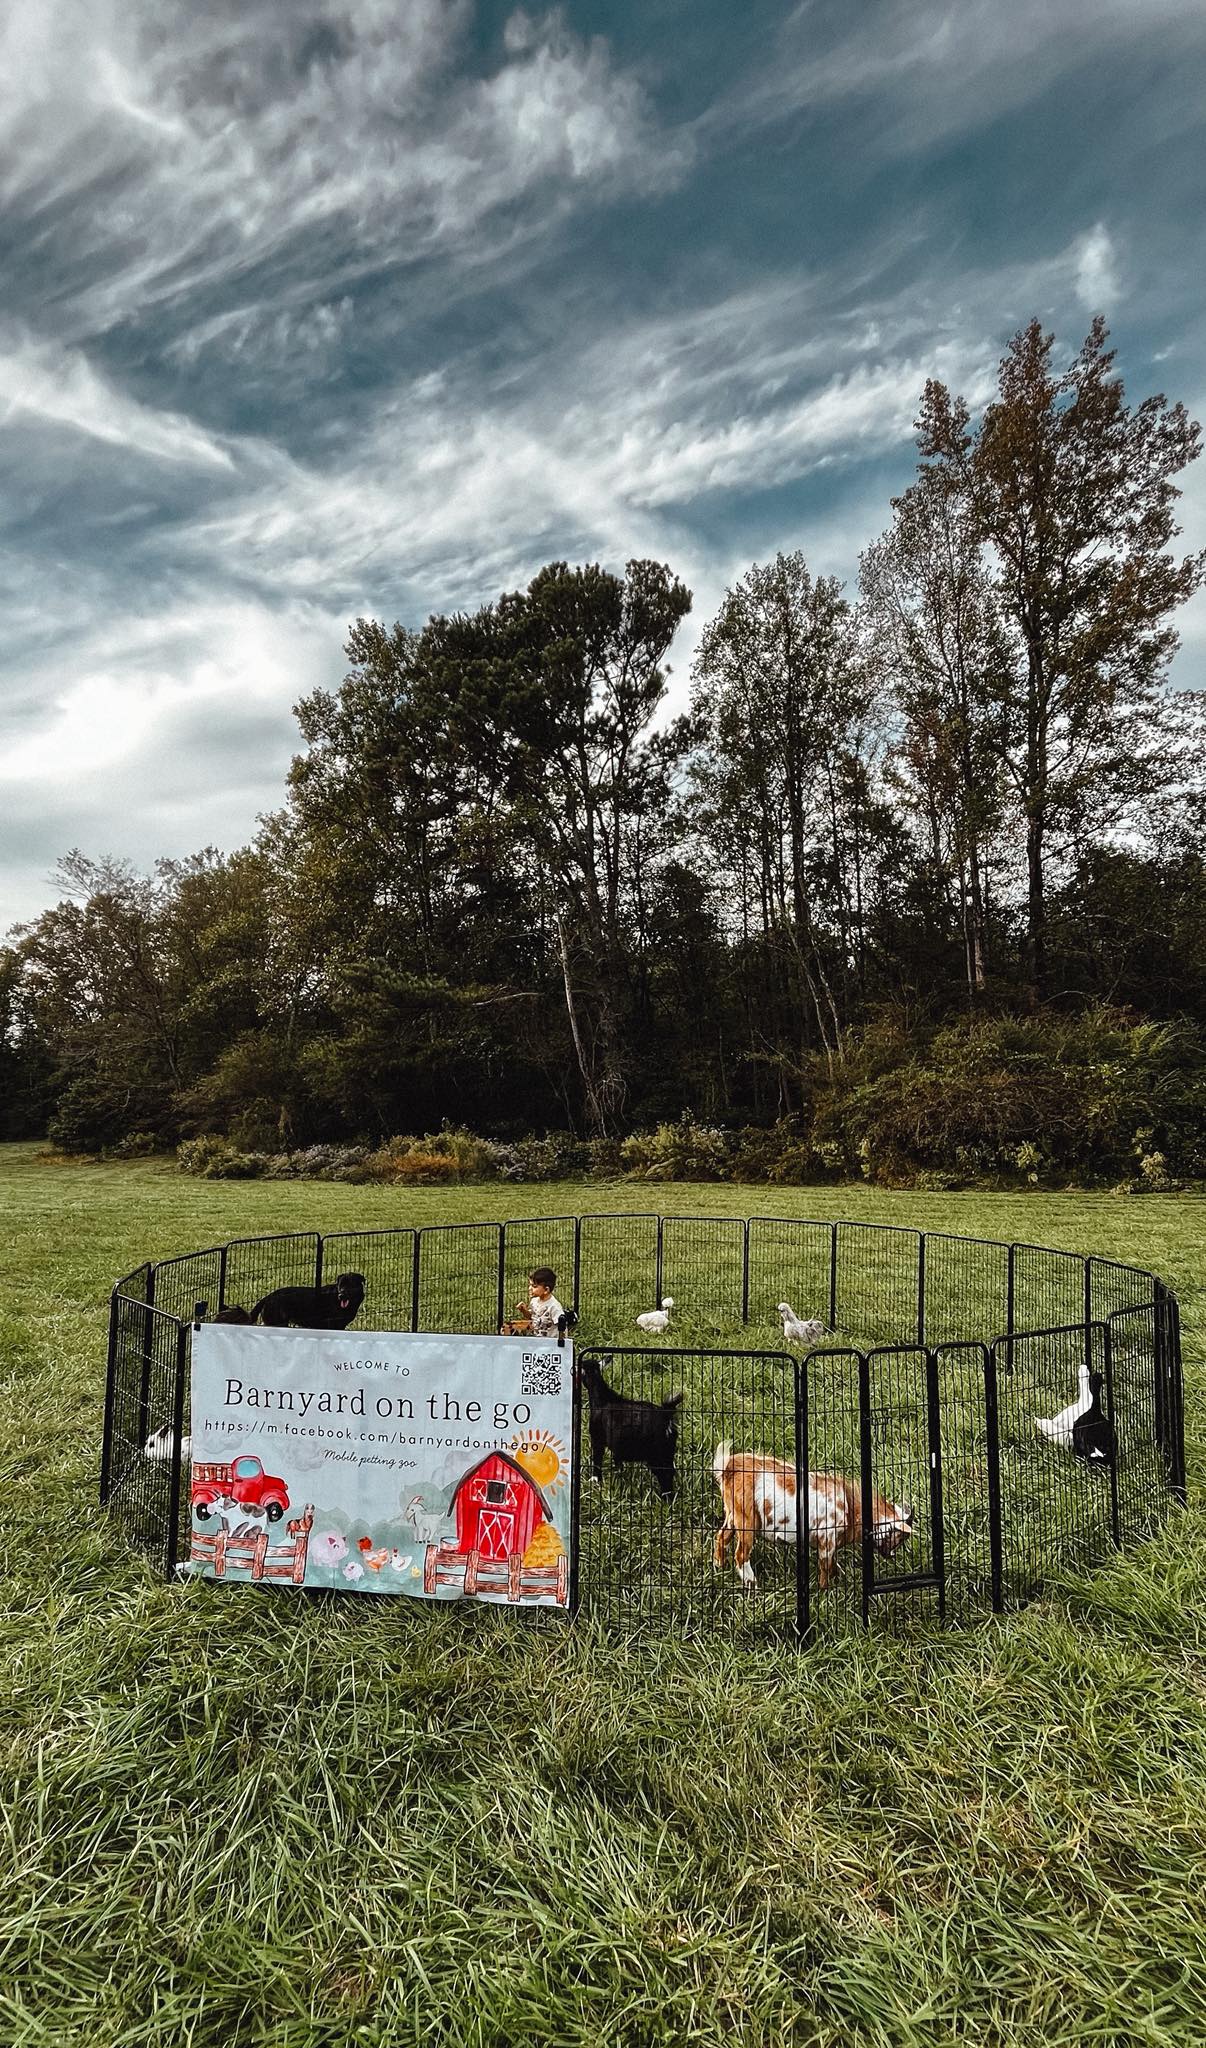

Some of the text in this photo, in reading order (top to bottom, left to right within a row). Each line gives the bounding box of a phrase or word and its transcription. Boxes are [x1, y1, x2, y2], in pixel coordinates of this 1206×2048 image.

[334, 1359, 411, 1377] WELCOME TO
[224, 1378, 532, 1430] Barnyard on the go
[204, 1419, 548, 1454] https://m.facebook.com/barnyardonthego/
[323, 1448, 418, 1470] Mobile petting zoo
